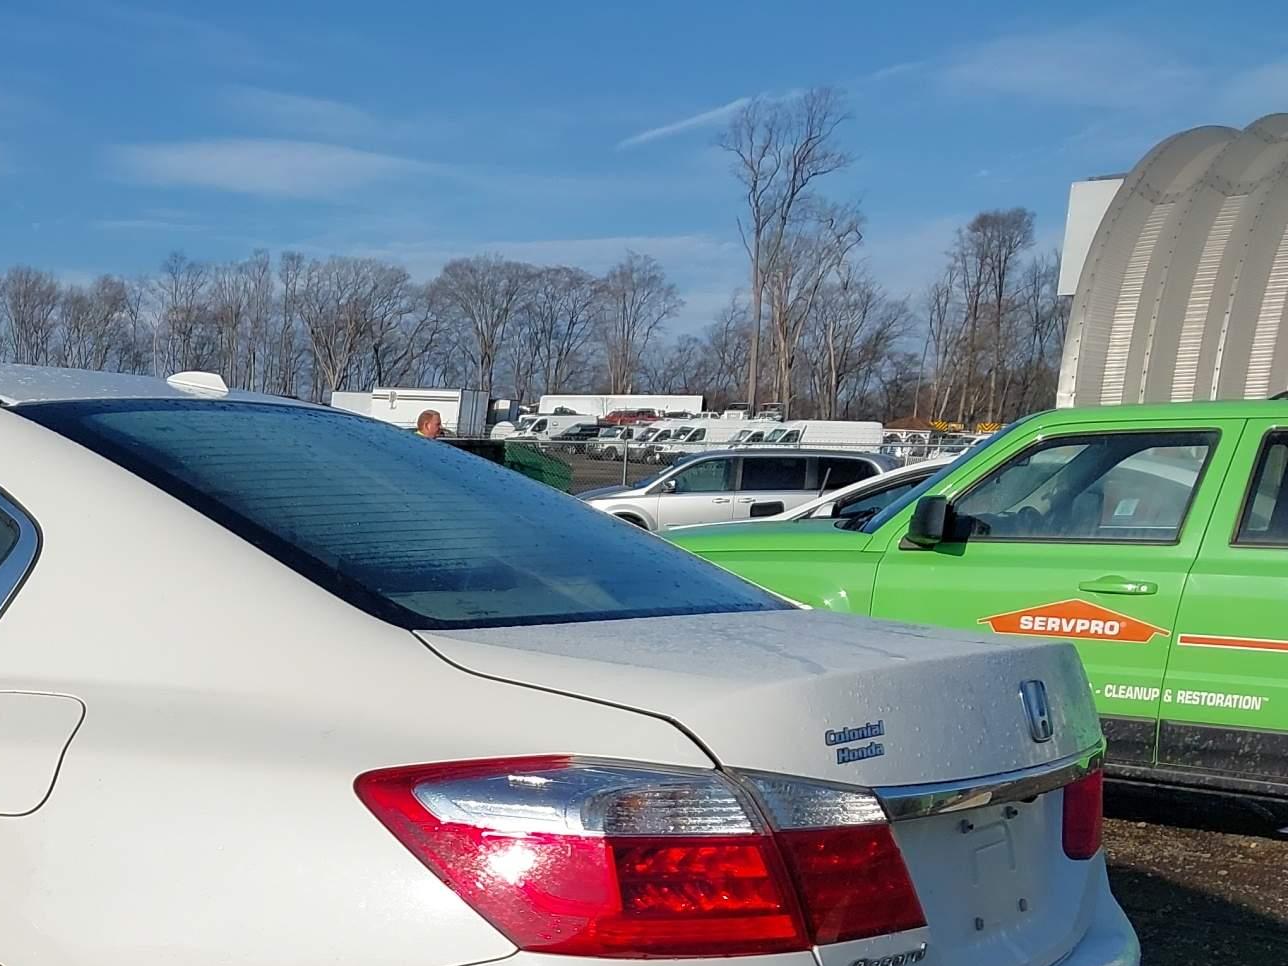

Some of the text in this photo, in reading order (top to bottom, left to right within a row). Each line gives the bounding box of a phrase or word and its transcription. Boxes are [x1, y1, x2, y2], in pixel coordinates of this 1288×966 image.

[1019, 615, 1120, 635] SERVPRO
[1104, 684, 1160, 701] CLEANUP
[1163, 689, 1172, 702] &
[1176, 690, 1262, 710] RESTORATION
[825, 720, 885, 746] Colonial
[836, 742, 885, 765] Honda
